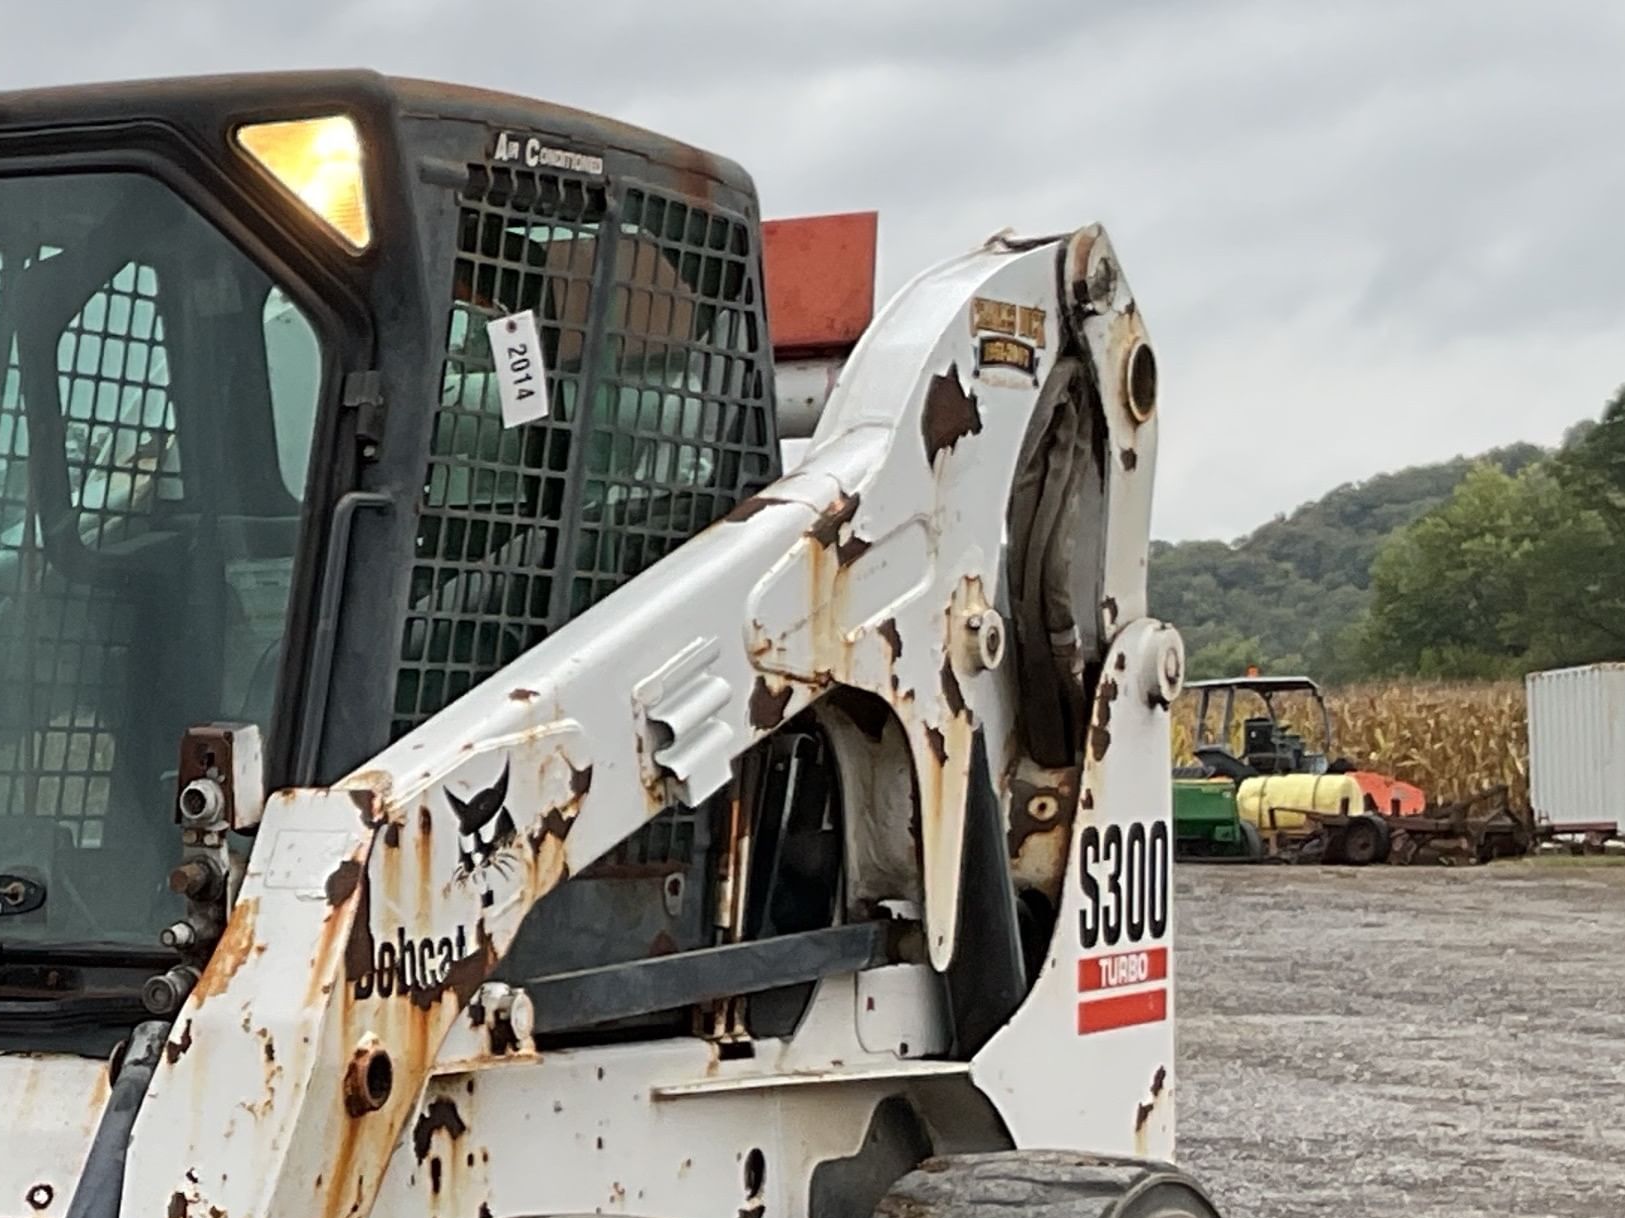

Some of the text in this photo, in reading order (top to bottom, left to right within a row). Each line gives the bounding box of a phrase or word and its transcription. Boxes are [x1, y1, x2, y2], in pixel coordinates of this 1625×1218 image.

[507, 343, 536, 401] 2014
[1079, 820, 1169, 949] S300
[1097, 952, 1149, 988] TURBO
